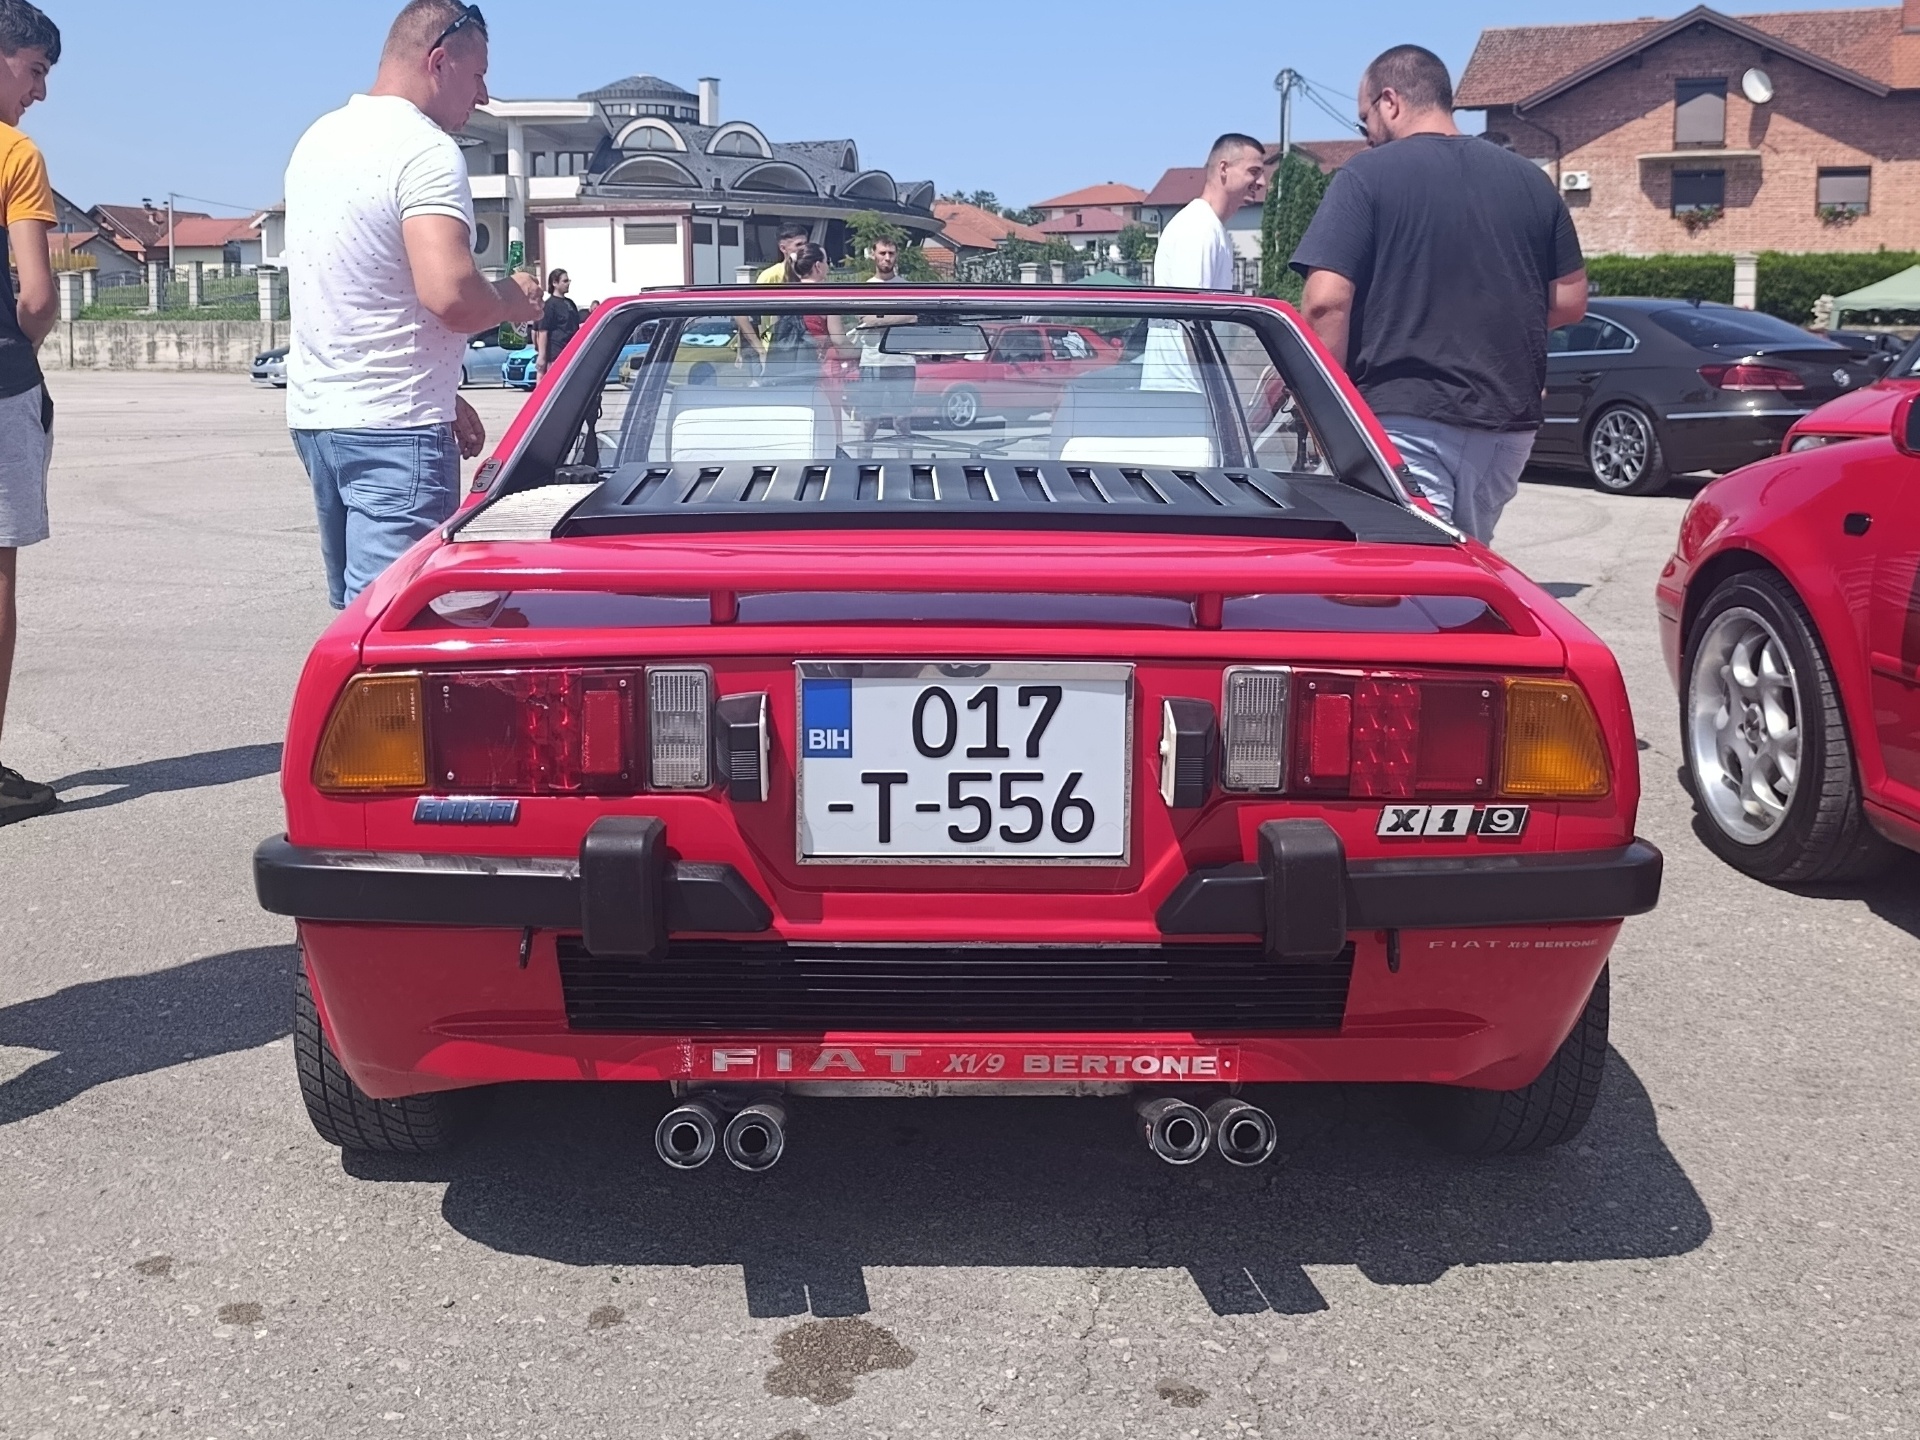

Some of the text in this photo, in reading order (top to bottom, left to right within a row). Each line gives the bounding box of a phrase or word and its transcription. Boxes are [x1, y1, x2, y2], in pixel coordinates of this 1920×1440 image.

[912, 686, 1062, 758] 017
[808, 729, 849, 749] BIH
[420, 803, 511, 819] FIAT
[1428, 940, 1501, 949] FIAT
[1534, 939, 1599, 949] BERTONE
[712, 1048, 1217, 1074] FIAT X1/9 BERTONE
